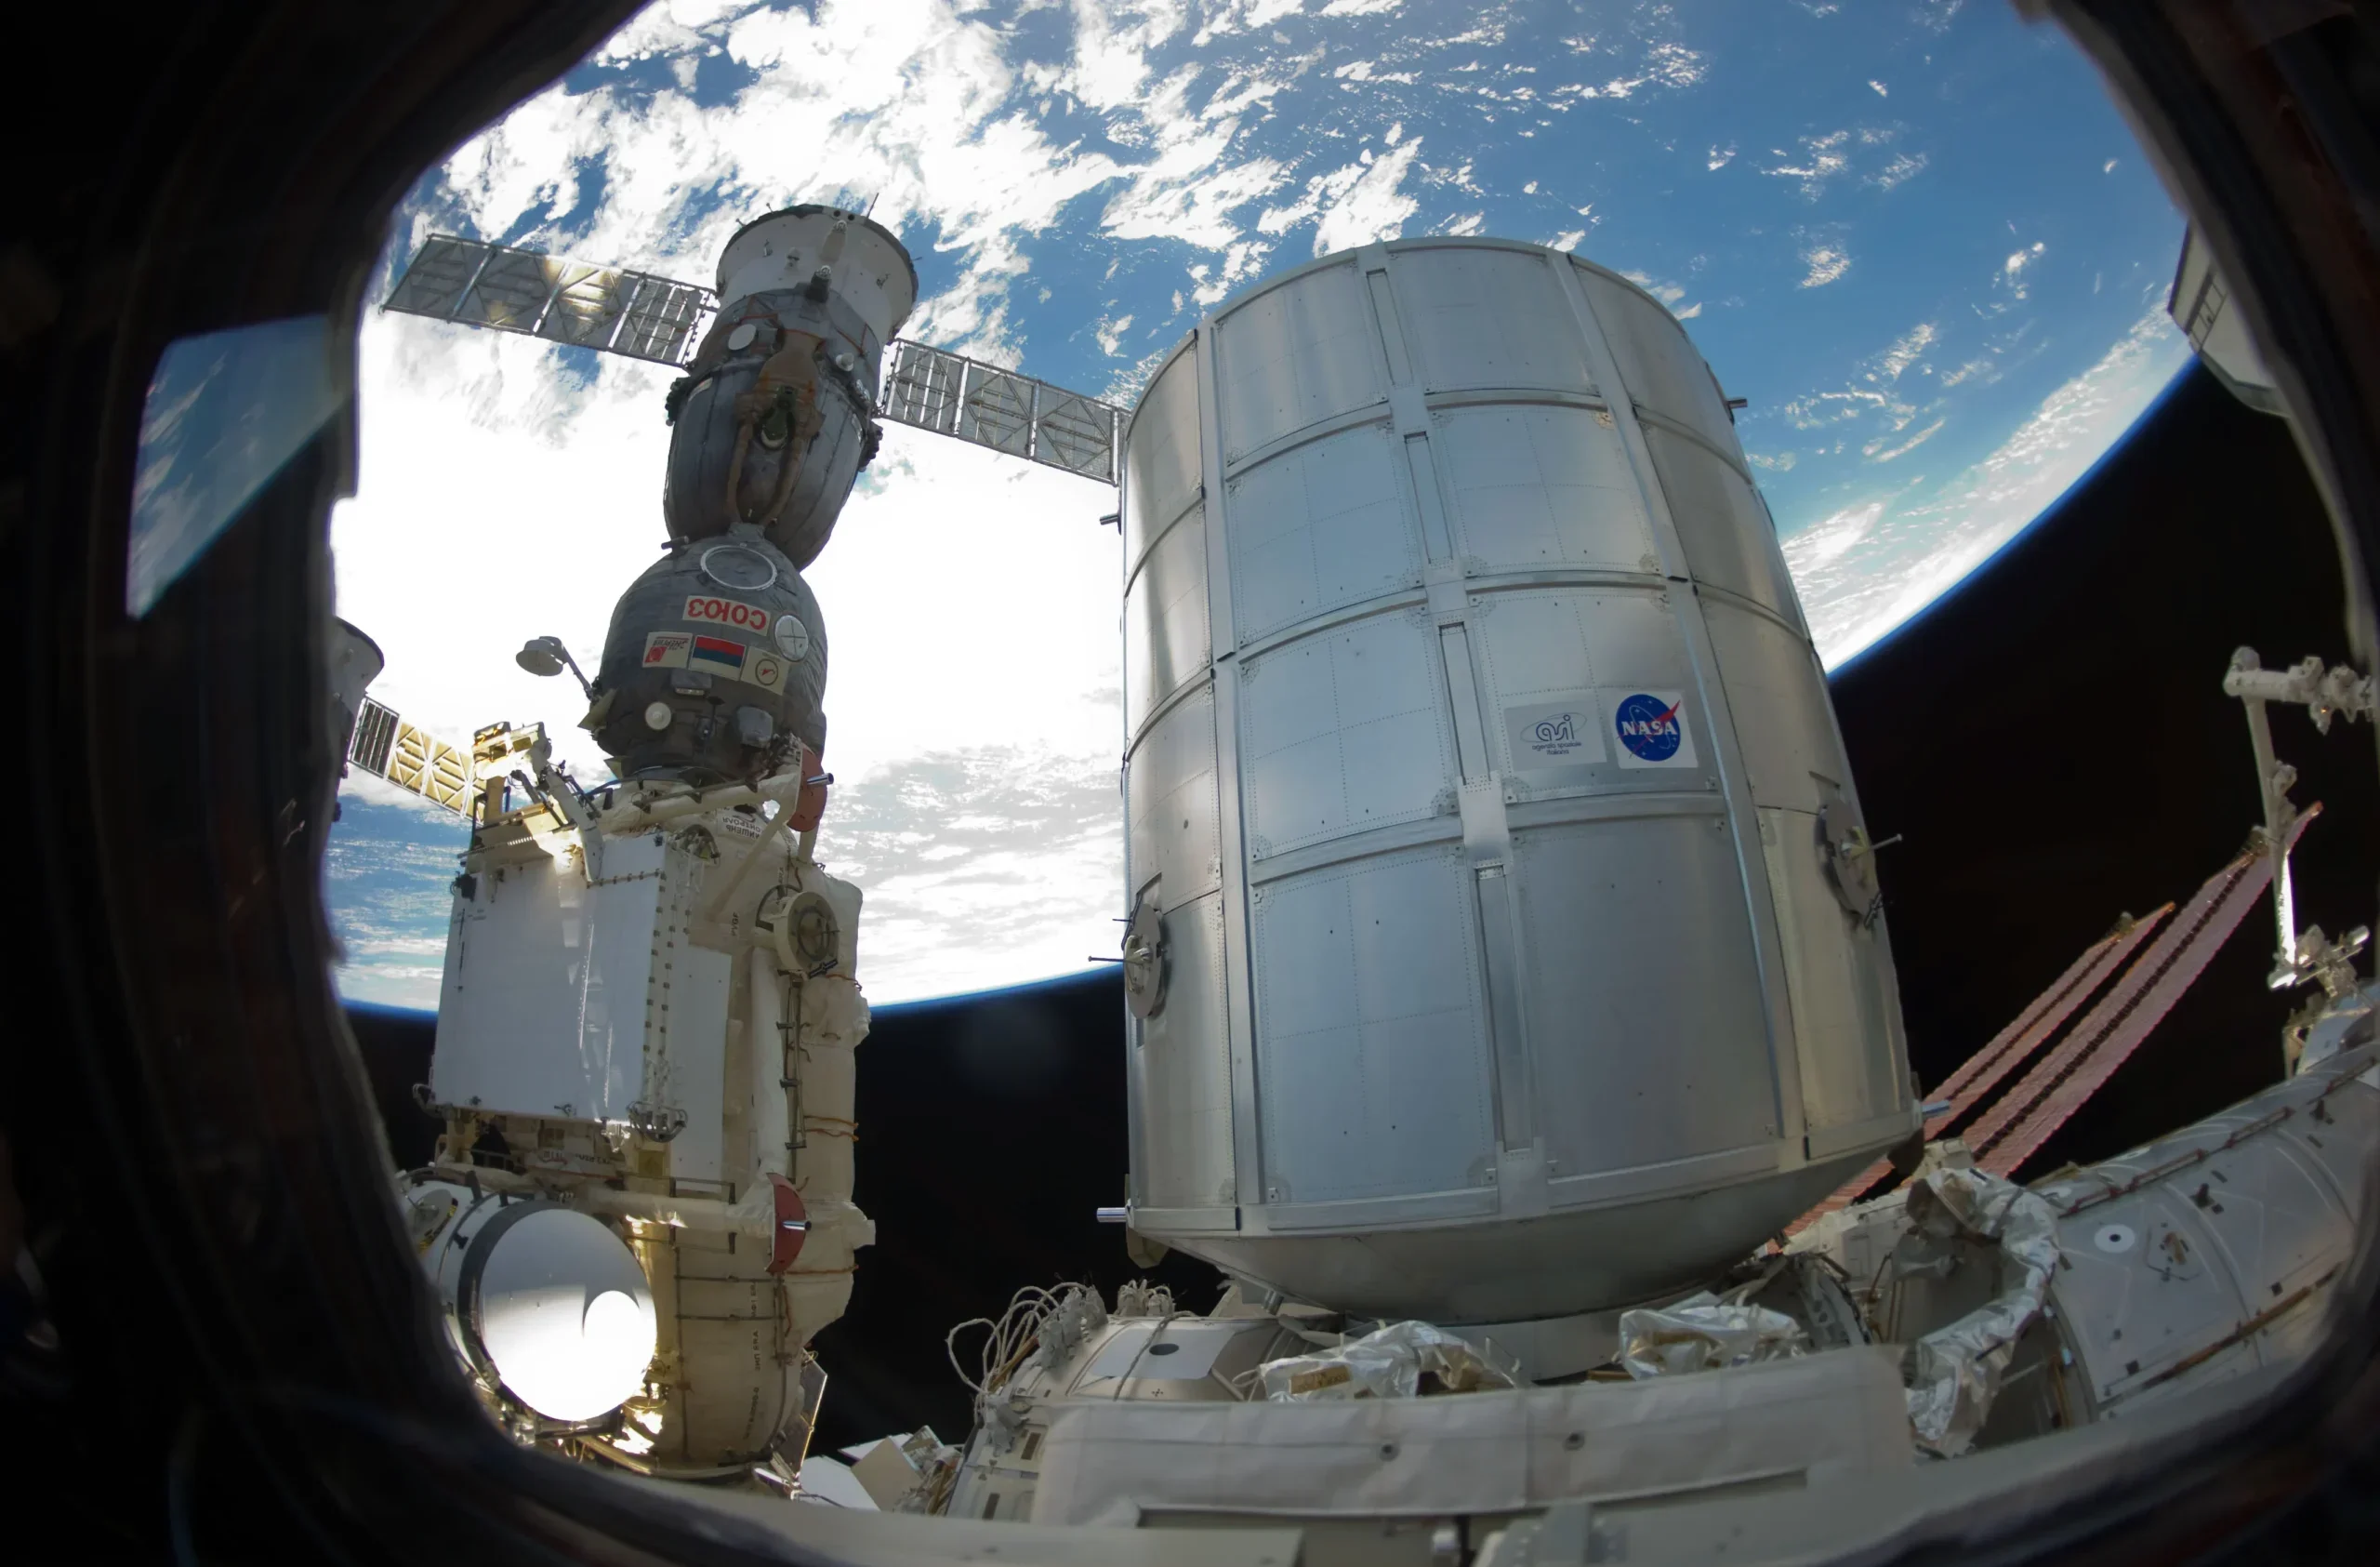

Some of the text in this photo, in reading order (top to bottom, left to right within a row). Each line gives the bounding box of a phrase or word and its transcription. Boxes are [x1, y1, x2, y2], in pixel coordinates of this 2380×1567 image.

[688, 598, 767, 631] СОЮЗ
[1621, 721, 1678, 736] NASA
[721, 817, 762, 834] ОНТРОЛЯ
